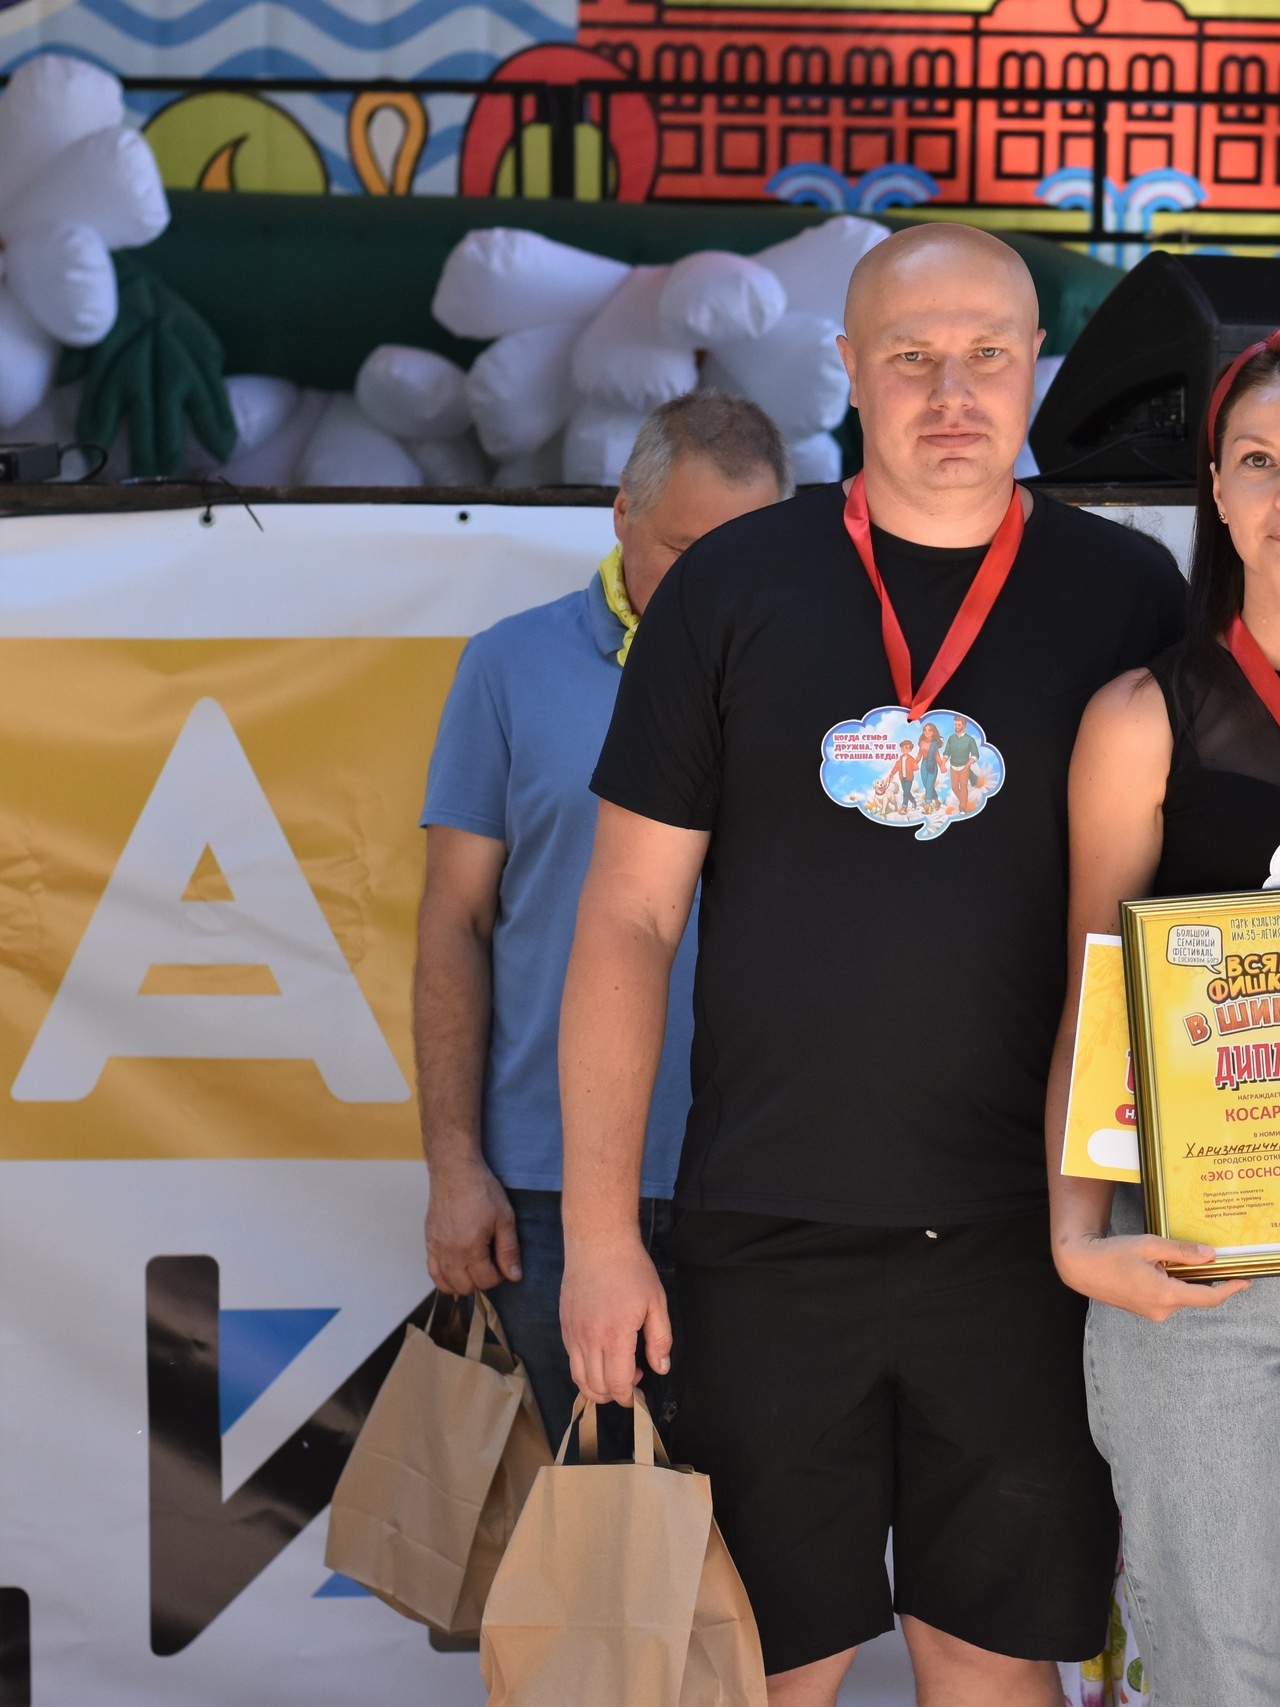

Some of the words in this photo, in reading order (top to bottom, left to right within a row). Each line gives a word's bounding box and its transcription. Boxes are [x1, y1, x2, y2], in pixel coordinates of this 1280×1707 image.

[834, 734, 860, 742] КОГДА
[834, 743, 872, 752] ДРУЖНА,
[1176, 926, 1210, 938] БОЛЬШОЙ
[1177, 938, 1215, 948] СЕМЕЙНЫЙ
[1173, 948, 1213, 957] ФЕСТИВАЛЬ
[1226, 954, 1279, 976] ВСЯ
[1184, 1014, 1210, 1043] В
[1213, 1155, 1262, 1165] ГОРОДСКОГО
[1200, 1169, 1234, 1182] «ЭХО
